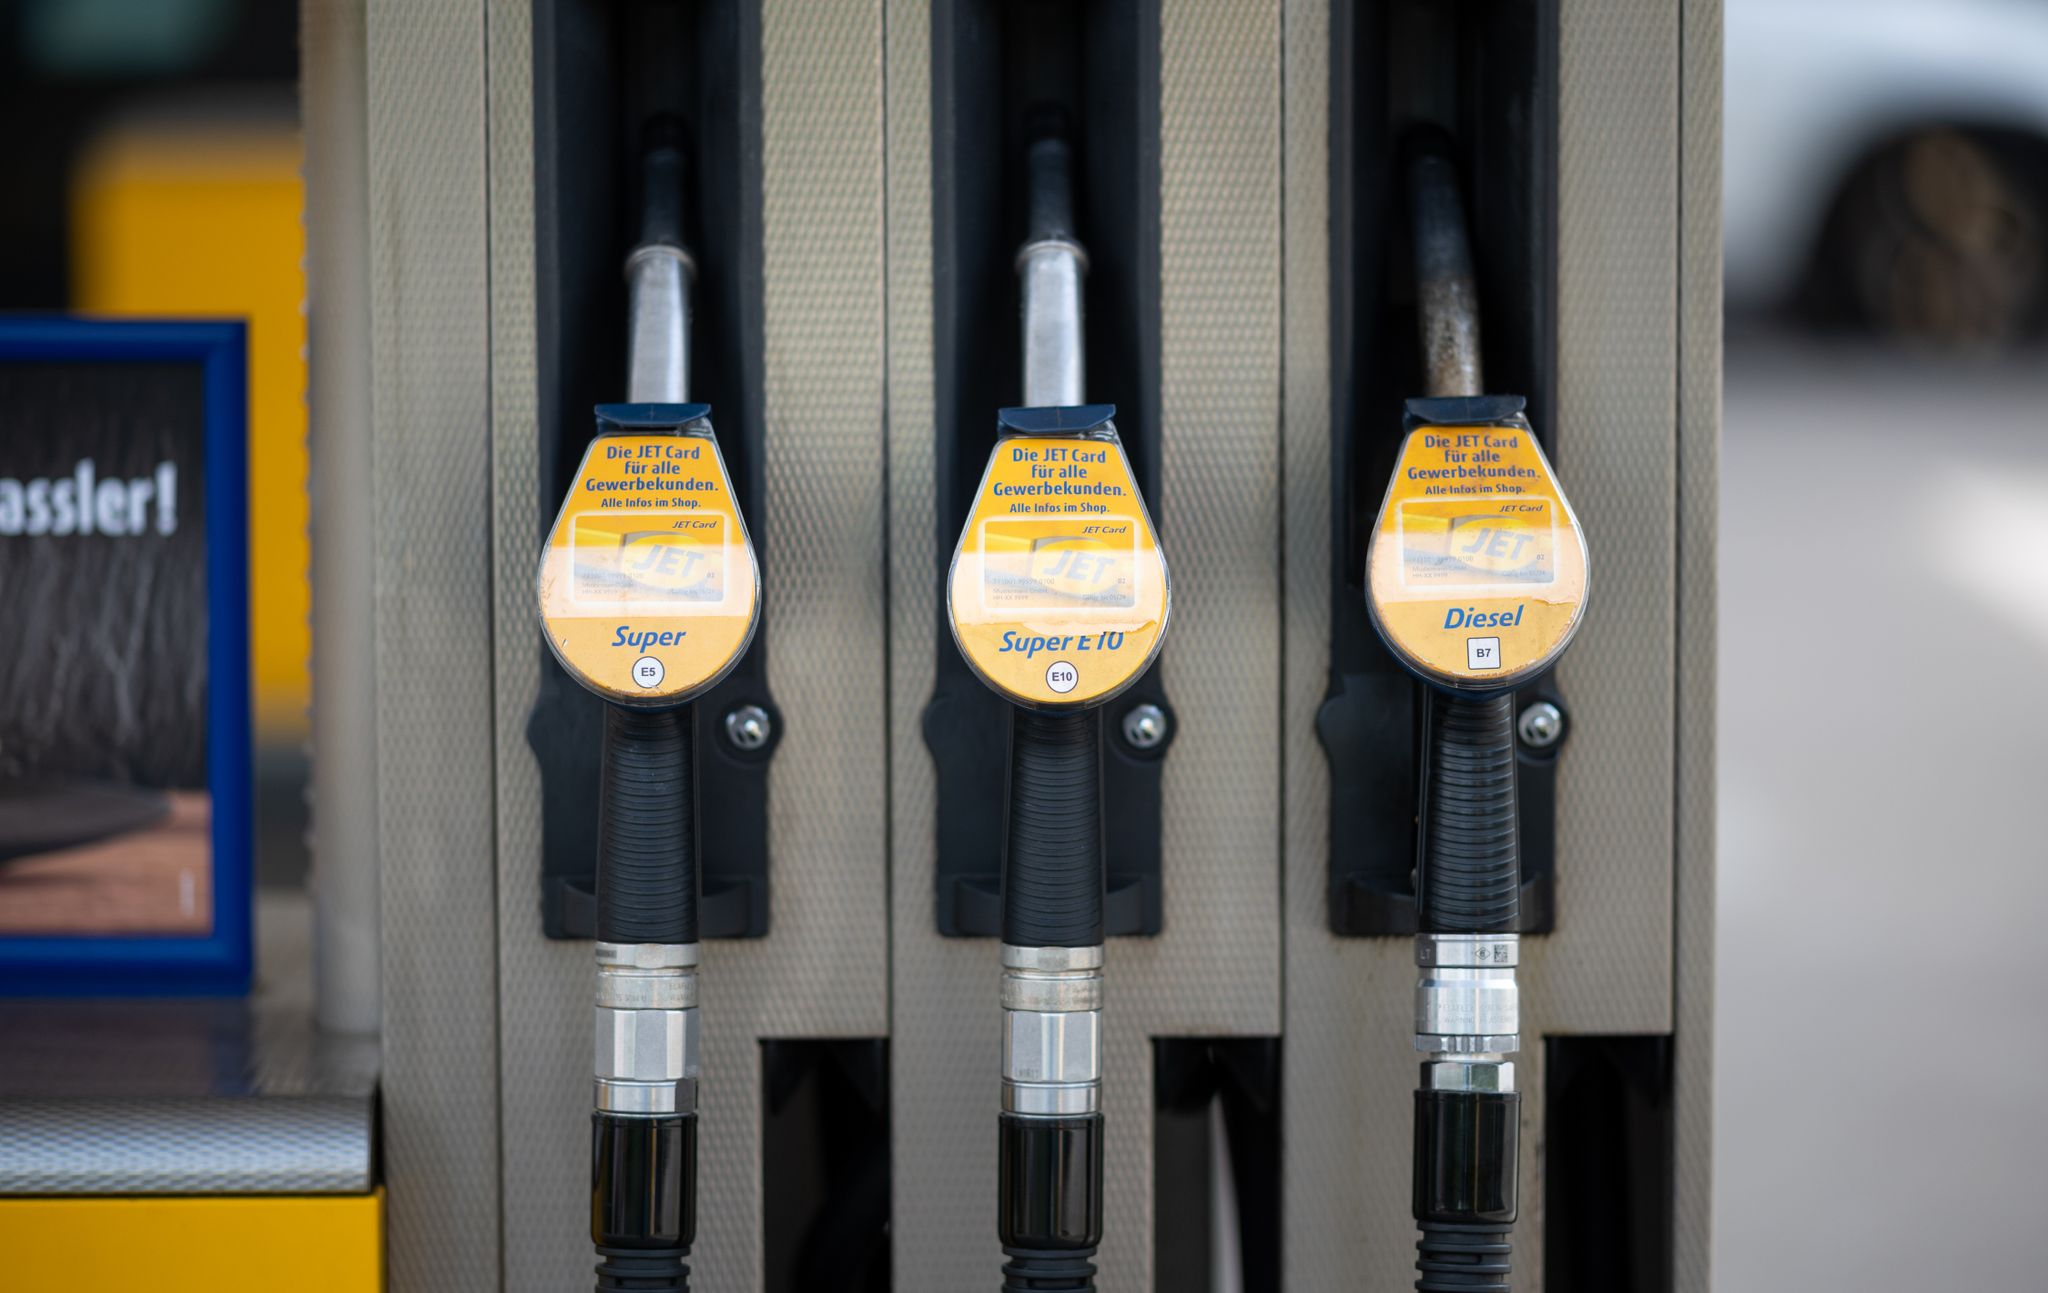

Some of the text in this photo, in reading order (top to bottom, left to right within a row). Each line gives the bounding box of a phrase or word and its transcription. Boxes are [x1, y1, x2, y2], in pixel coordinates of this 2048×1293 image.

[1425, 435, 1518, 448] Die JET Card
[607, 445, 700, 459] Die JET Card
[1013, 448, 1106, 463] Die JET Card
[1445, 450, 1500, 462] für alle
[625, 461, 680, 474] für alle
[1032, 465, 1087, 478] für alle
[1408, 465, 1540, 479] Gewerbekunden.
[586, 477, 718, 491] Gewerbekunden.
[994, 481, 1126, 496] Gewerbekunden.
[1425, 484, 1525, 494] Alle Infos im Shop.
[0, 457, 178, 537] assler!
[601, 497, 701, 509] Alle Infos im Shop.
[1010, 503, 1110, 514] Alle Infos im Shop.
[1461, 528, 1534, 560] JET
[632, 544, 704, 578] JET
[1043, 550, 1115, 584] JET
[1443, 604, 1525, 630] Diesel
[611, 626, 687, 653] Super
[999, 631, 1073, 659] Super
[1476, 648, 1491, 658] B7
[641, 667, 656, 677] E5
[1051, 672, 1072, 681] E10
